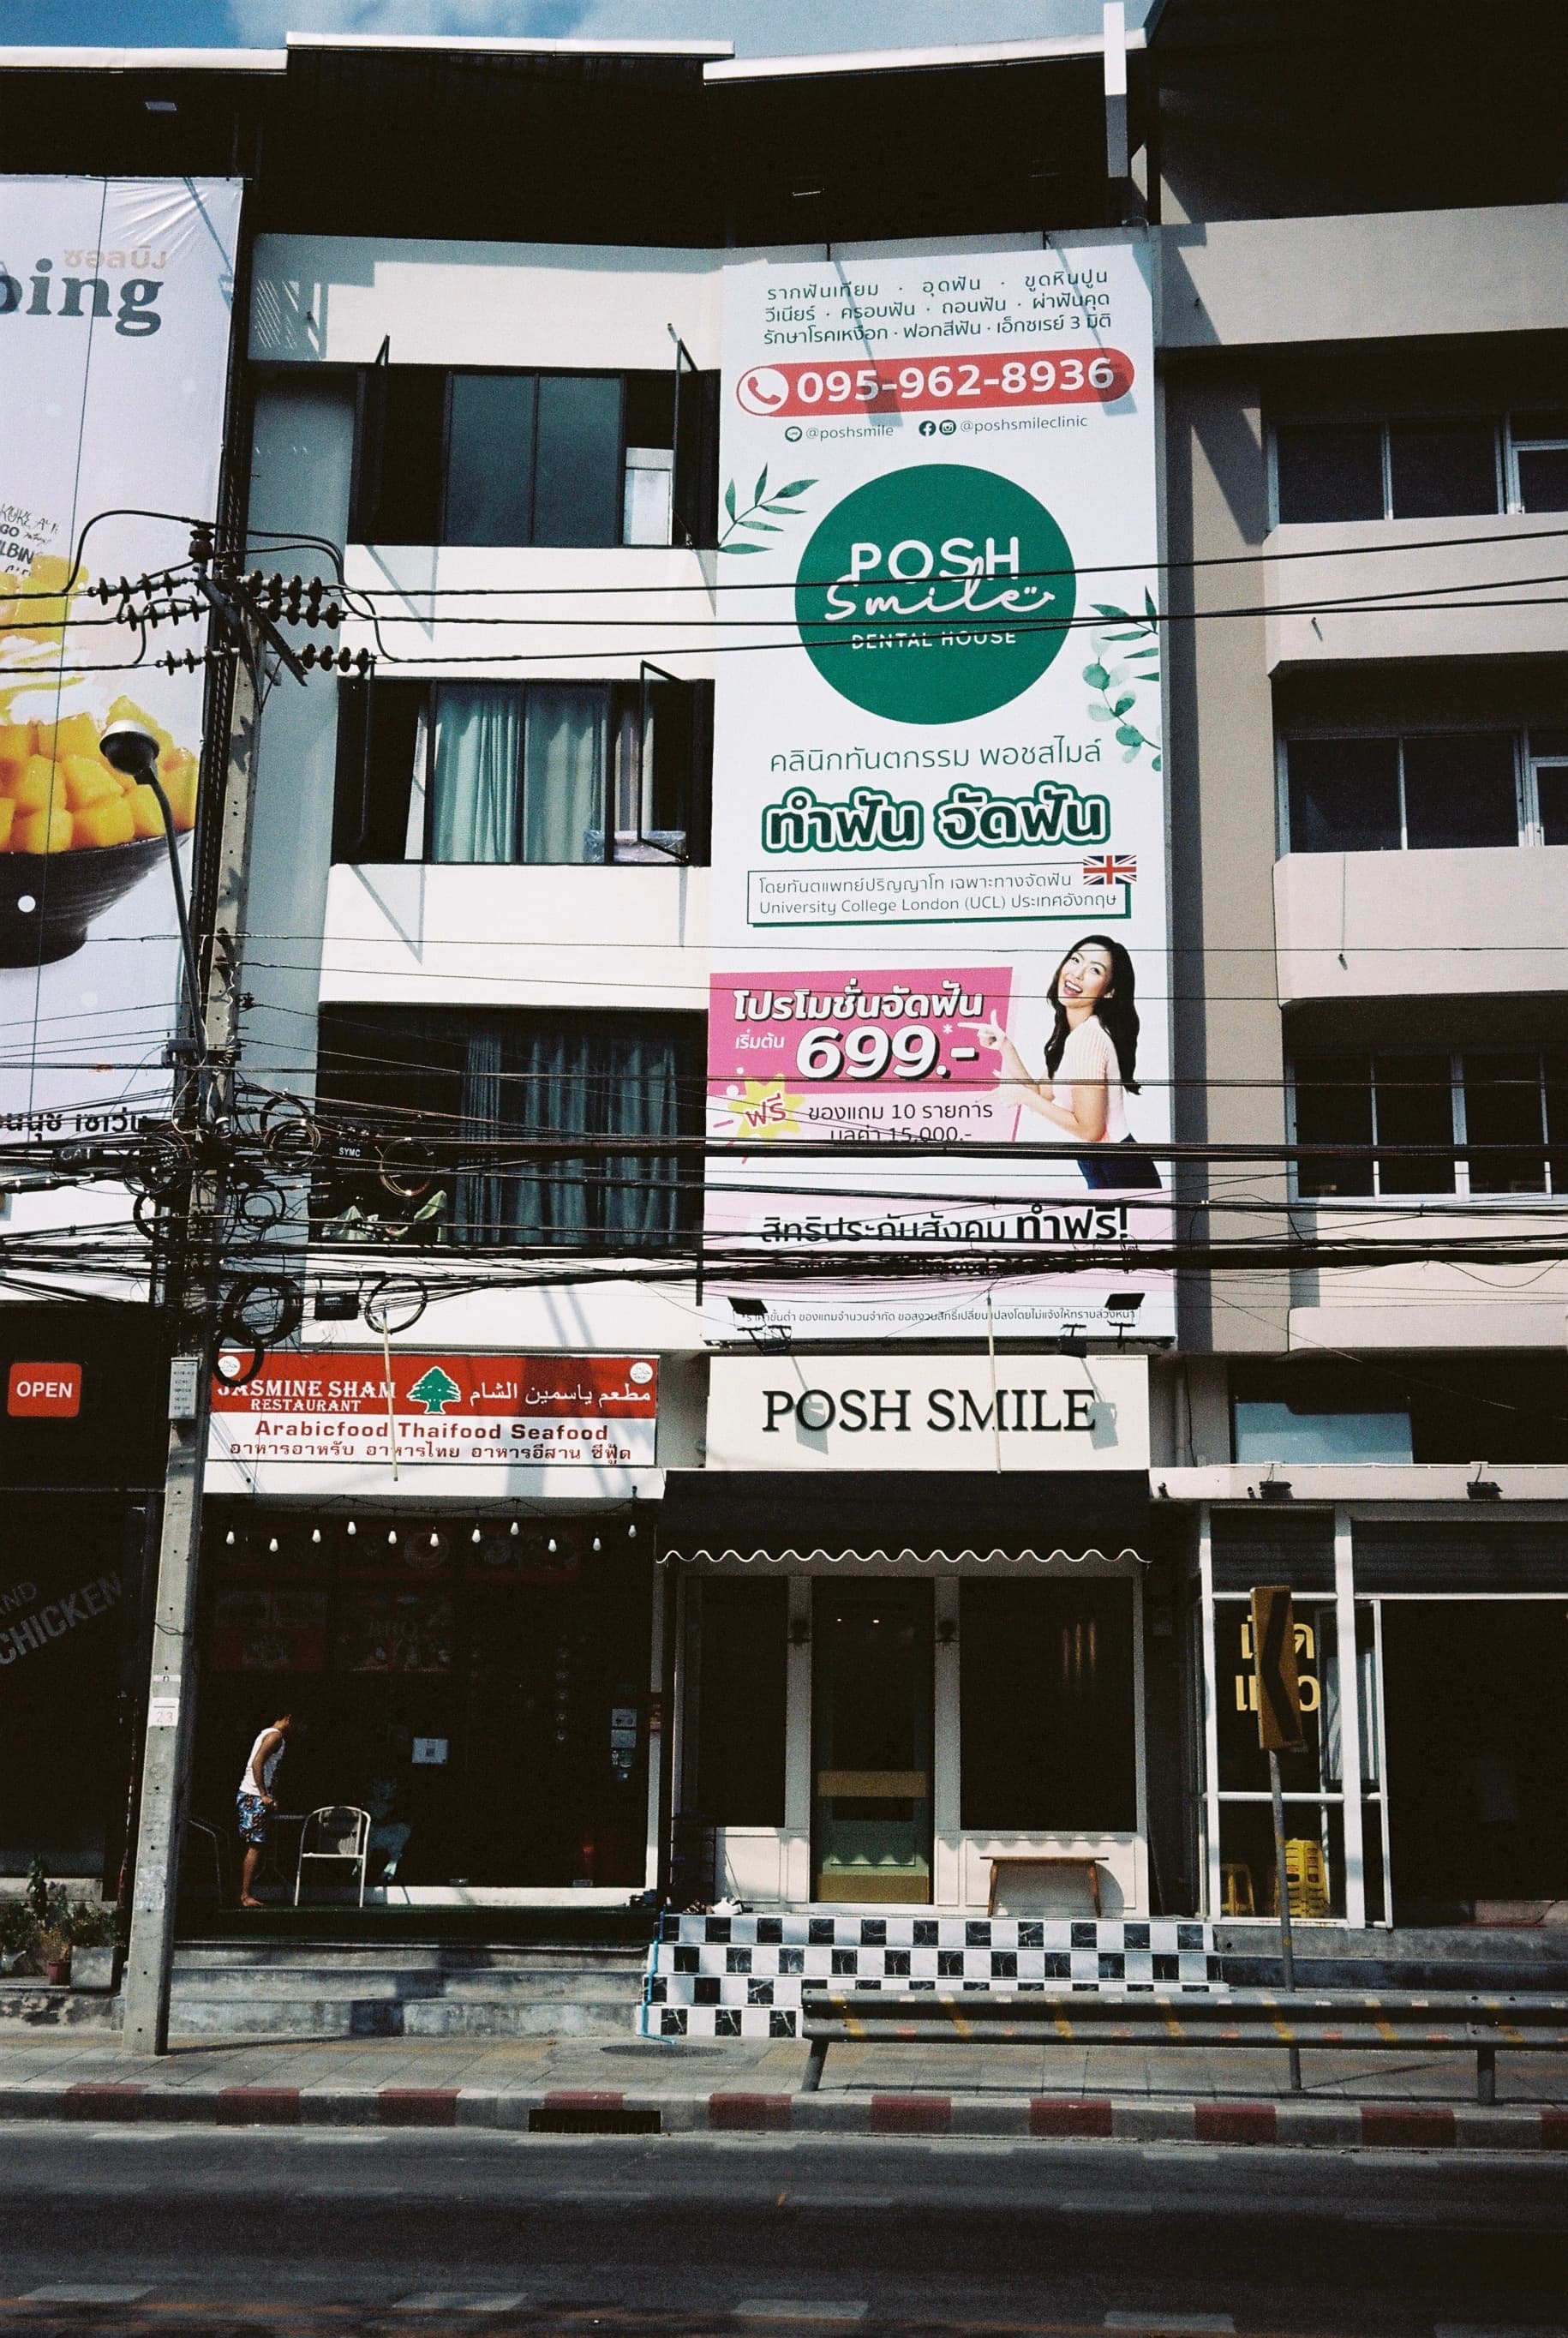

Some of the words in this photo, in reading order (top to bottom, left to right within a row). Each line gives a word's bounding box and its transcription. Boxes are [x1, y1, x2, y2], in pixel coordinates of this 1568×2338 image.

[768, 281, 878, 300] รากฟันเทียม
[923, 276, 980, 297] อุดฟัน
[1025, 269, 1108, 291] ขูดหินปูน
[765, 305, 815, 322] วีเนียร์
[841, 302, 915, 320] ครอบฟัน
[943, 297, 1006, 315] ถอนฟัน
[1033, 292, 1110, 310] ผ่าฟันคุด
[764, 325, 888, 345] รักษาโรคเหงือก
[904, 321, 981, 339] ฟอกสีฟัน
[997, 315, 1064, 333] เอ็กซเรย์
[1071, 318, 1080, 330] 3
[1086, 313, 1112, 329] มิติ
[796, 357, 1113, 402] 095-962-8936
[806, 425, 894, 441] @poshsmile
[960, 416, 1087, 435] @poshsmileclinic
[0, 541, 34, 565] LBIN
[851, 537, 1019, 586] POSH
[824, 556, 1055, 620] Smile
[852, 632, 933, 650] DENTAL
[942, 630, 1017, 646] HOUSE
[770, 746, 970, 772] คลินิกทันตกรรม
[980, 734, 1101, 765] พอชสไมล์
[766, 790, 919, 848] ทำฟัน
[938, 785, 1105, 844] จัดฟัน
[759, 873, 944, 894] โดยทันตแพทย์ปริญญาโท
[951, 871, 1072, 889] เฉพาะทางจัดฟัน
[759, 901, 836, 916] University
[841, 899, 896, 914] College
[902, 897, 959, 911] London
[964, 895, 1006, 911] (UCL)
[1011, 893, 1117, 910] ประเทศอังกฤษ
[733, 978, 984, 1021] โปรโมชั่นจัดฟัน
[735, 1032, 784, 1051] เริ่มต้น
[745, 1093, 787, 1128] ฟรี
[809, 1104, 883, 1121] ของแถม
[891, 1103, 916, 1119] 10
[923, 1101, 993, 1118] รายการ
[830, 1125, 881, 1141] มลค่า
[889, 1125, 972, 1143] 15,000.-
[1017, 1203, 1128, 1239] ทำฟรี!
[16, 1381, 73, 1399] OPEN
[218, 1380, 323, 1397] JASMINE
[328, 1381, 396, 1399] SHAM
[470, 1382, 518, 1406] الشام
[525, 1384, 593, 1405] ياسمين
[599, 1383, 651, 1407] مطعم
[251, 1398, 362, 1412] RESTAURANT
[762, 1388, 911, 1432] POSH
[927, 1388, 1096, 1432] SMILE
[255, 1420, 388, 1437] Arabicfood
[398, 1422, 501, 1439] Thaifood
[511, 1424, 608, 1441] Seafood
[230, 1441, 355, 1455] อาหารอาหรับ
[366, 1441, 460, 1458] อาหารไทย
[472, 1444, 581, 1460] อาหารอีสาน
[592, 1443, 631, 1465] ซีฟู้ด
[0, 1581, 38, 1616] ND
[0, 1571, 123, 1665] CHICKEN
